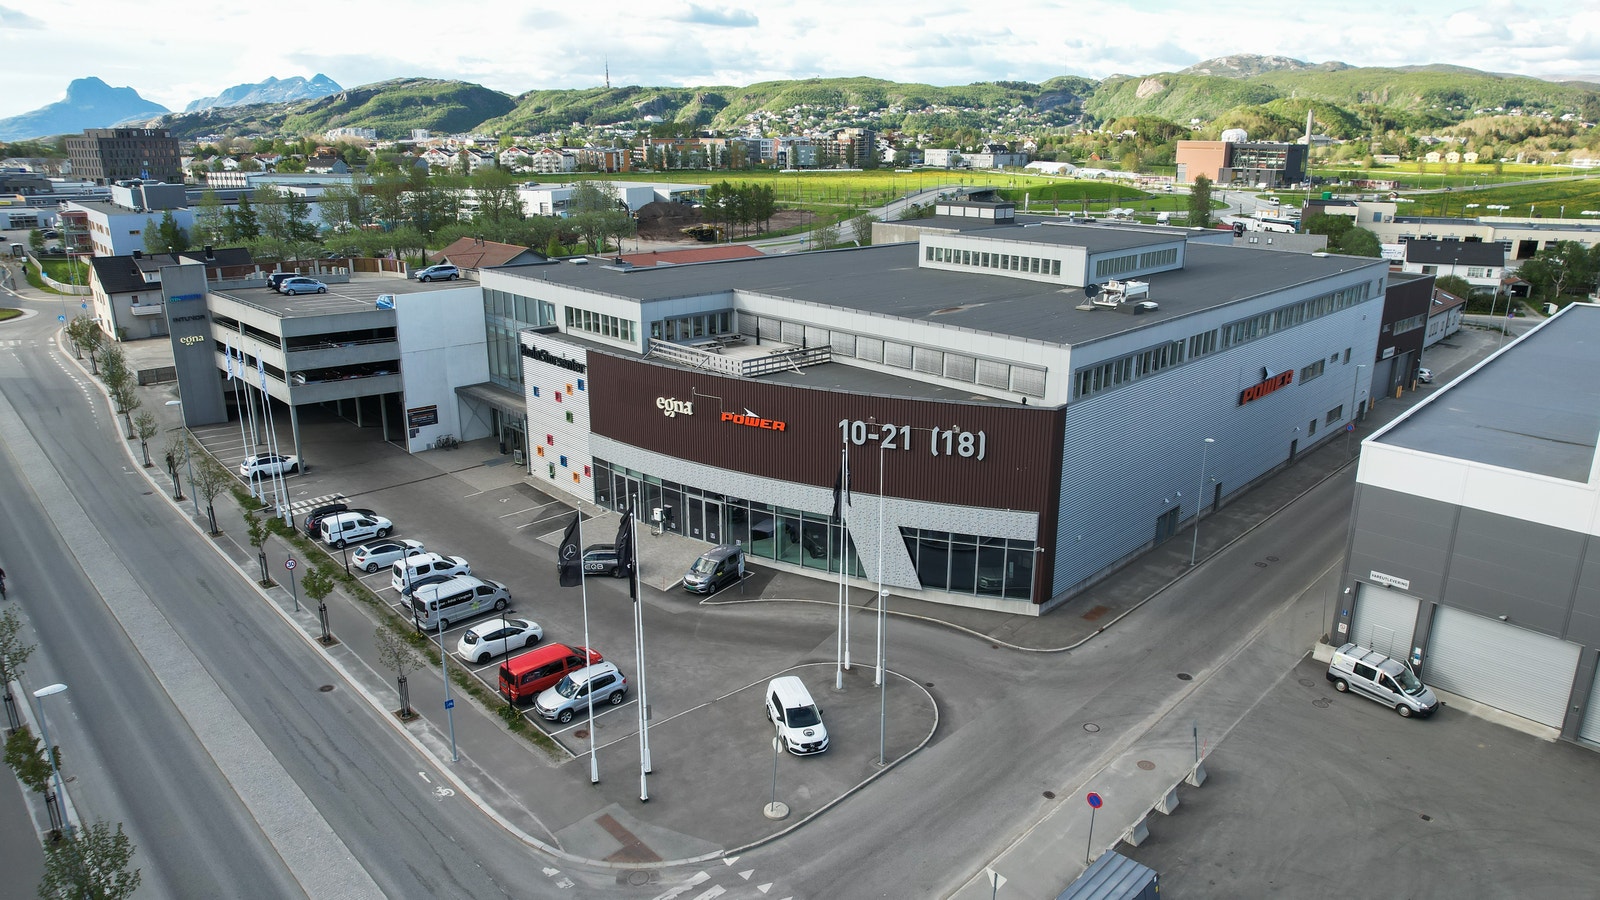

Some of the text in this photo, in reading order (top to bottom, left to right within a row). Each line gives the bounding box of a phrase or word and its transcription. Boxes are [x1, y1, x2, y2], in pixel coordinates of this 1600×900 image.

[180, 335, 204, 346] egna
[1241, 369, 1295, 406] POWER
[656, 396, 693, 418] egna
[721, 411, 786, 431] POWER
[838, 418, 986, 461] 10-21 (18)
